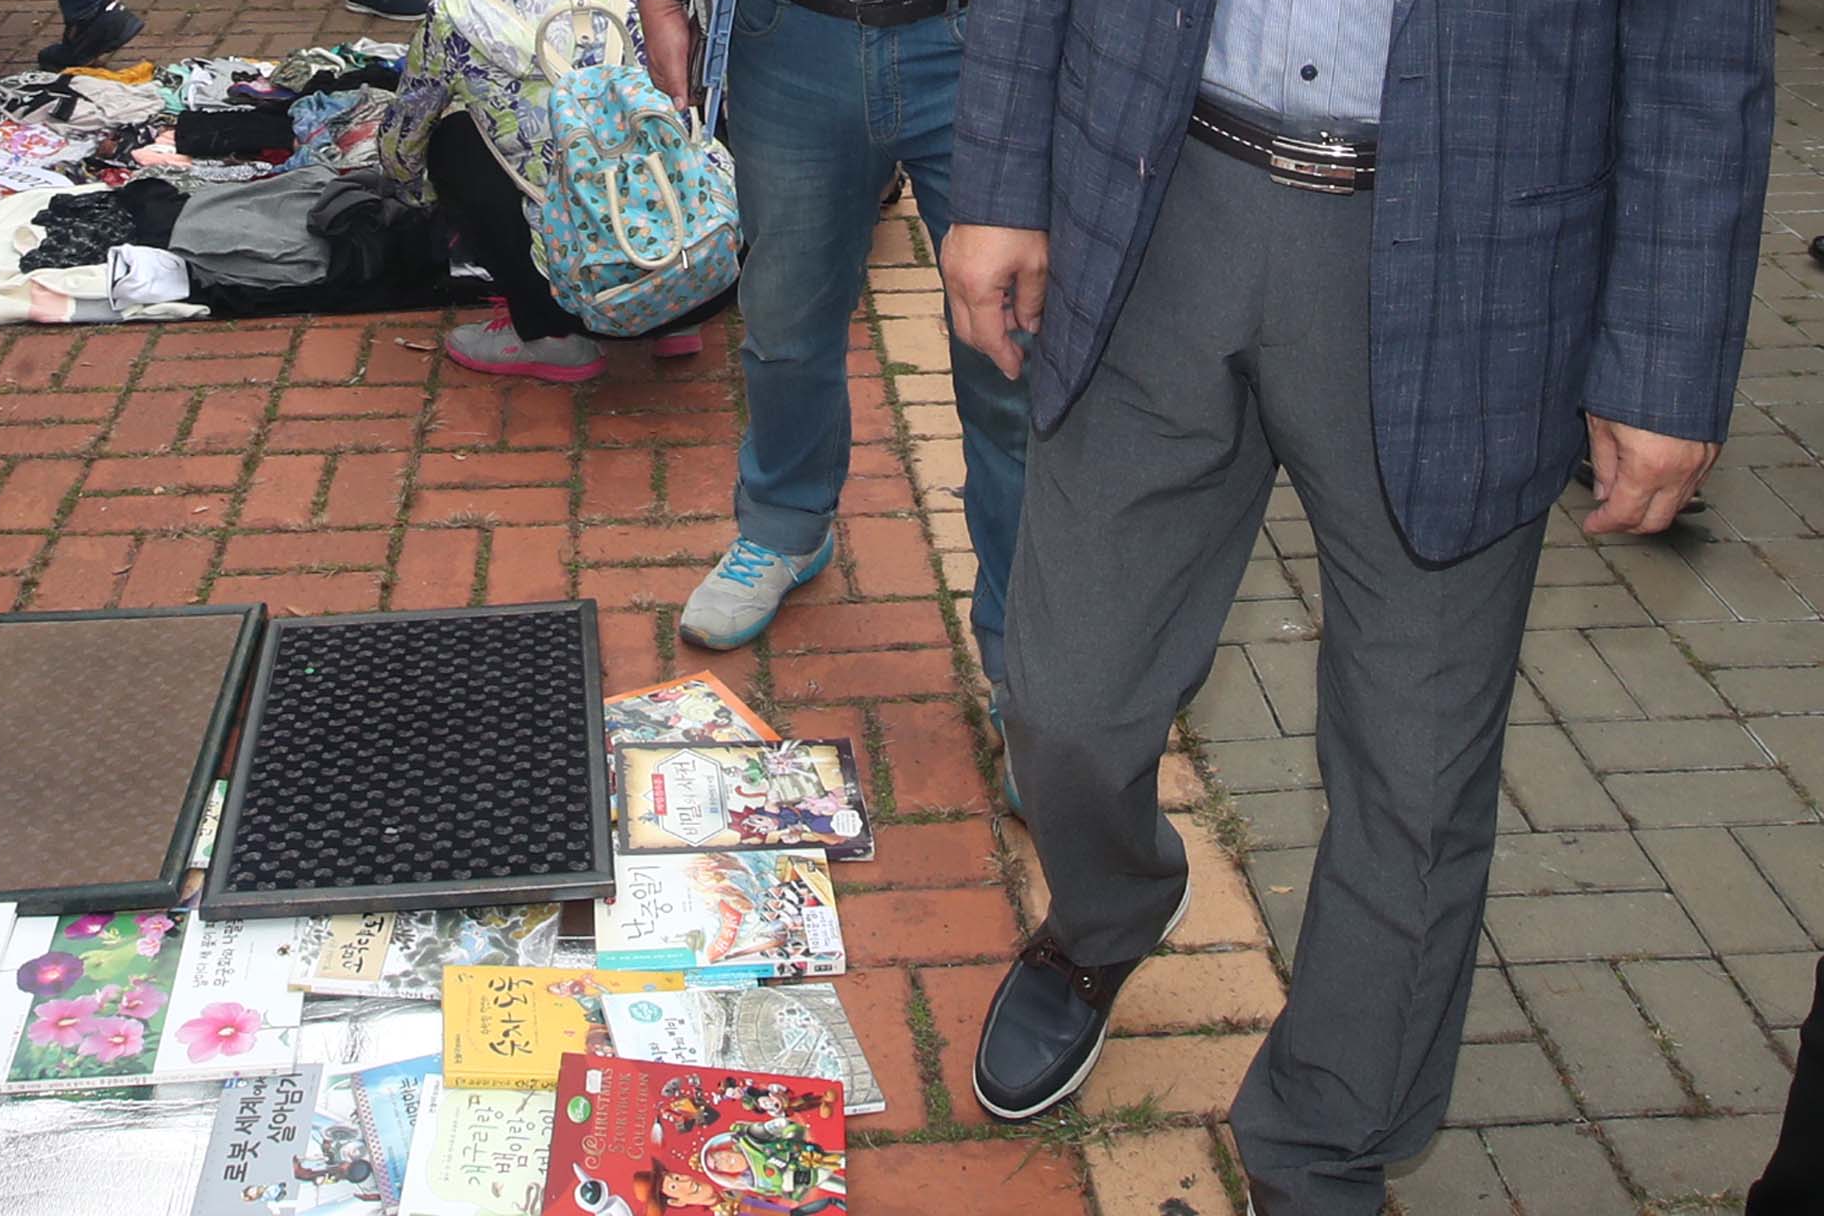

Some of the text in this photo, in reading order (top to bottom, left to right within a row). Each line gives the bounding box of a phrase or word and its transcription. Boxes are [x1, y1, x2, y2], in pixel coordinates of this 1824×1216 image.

[621, 864, 673, 942] 난중일기
[267, 1071, 305, 1145] 살아남기
[460, 1105, 495, 1187] 개구리랑
[223, 1136, 260, 1184] 로봇
